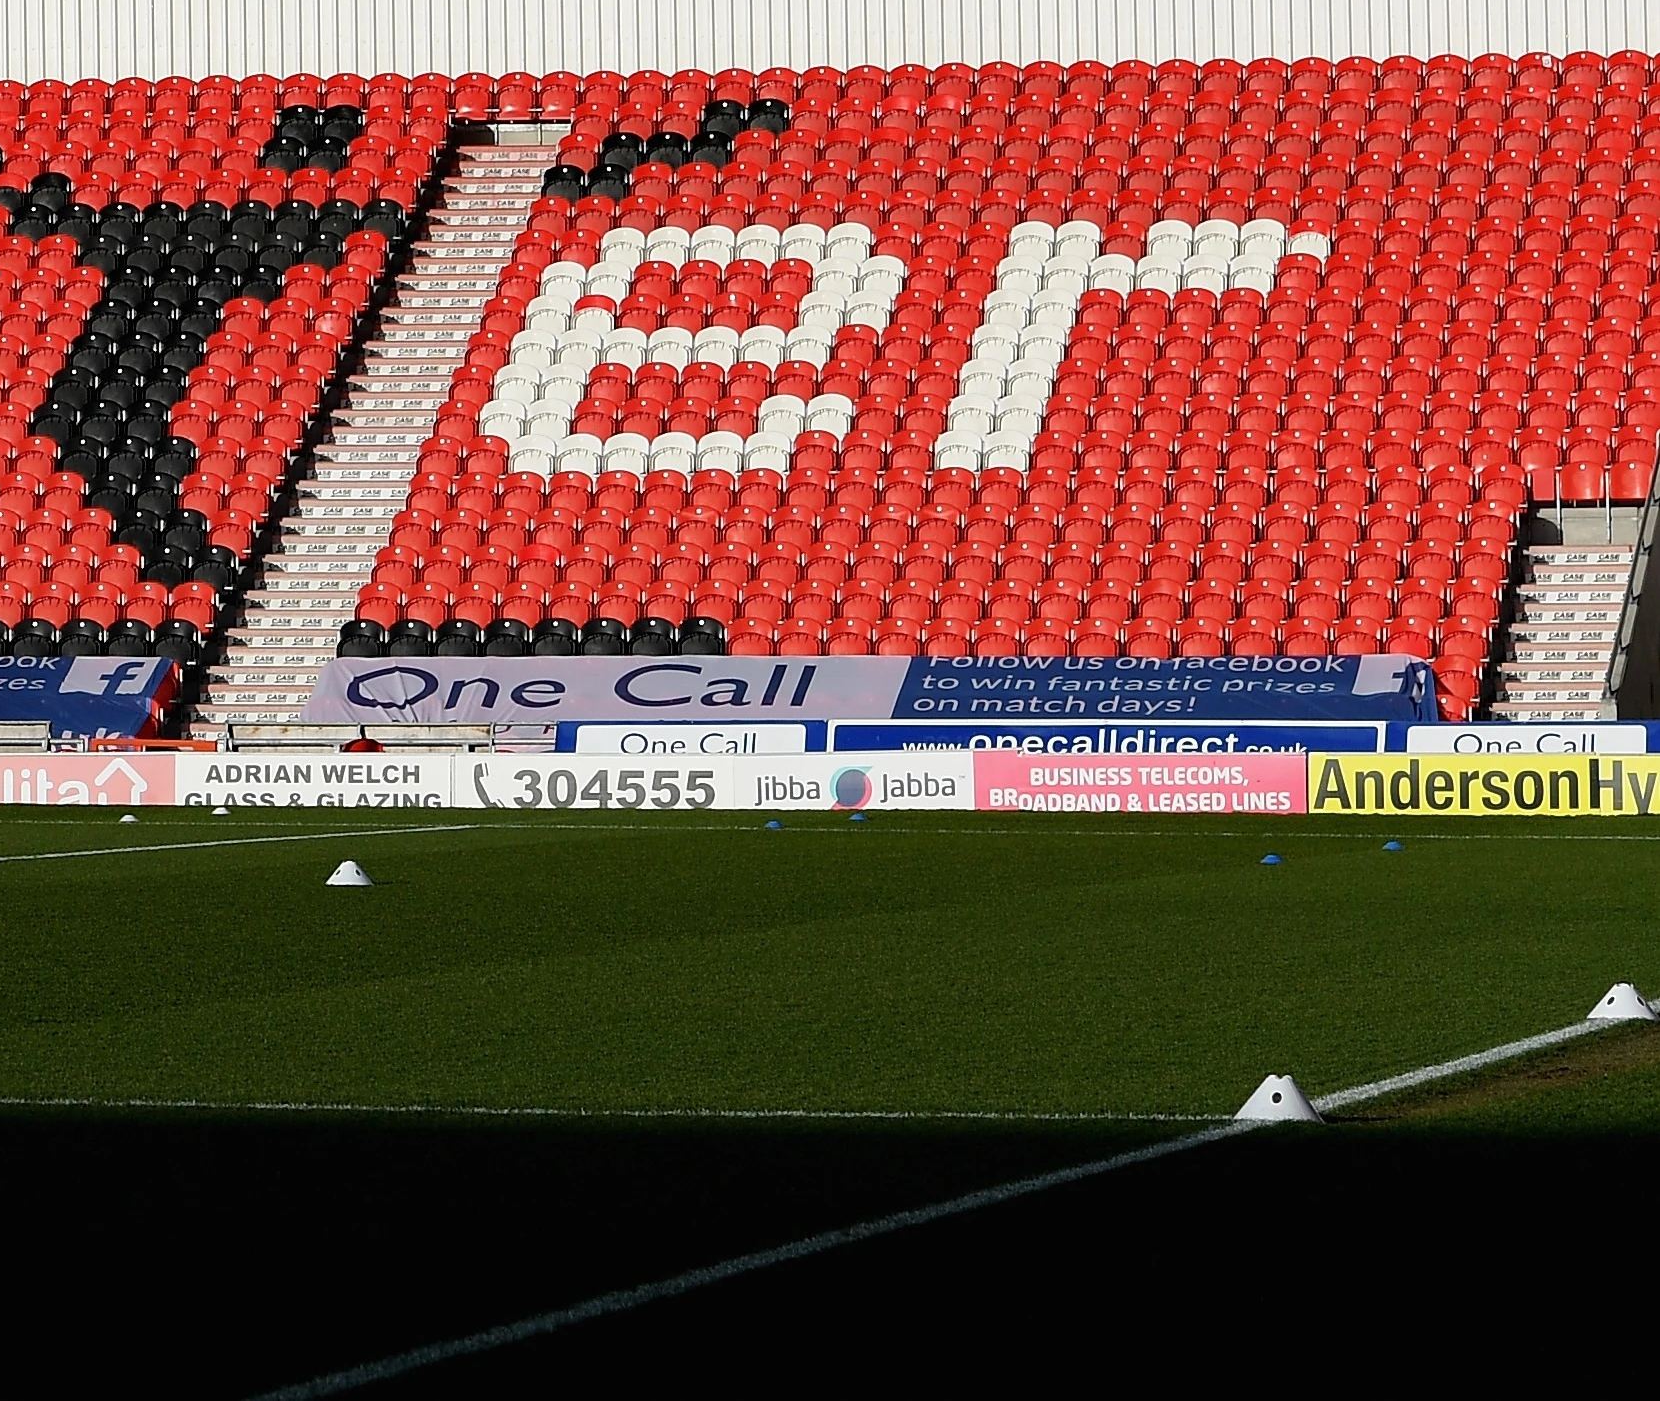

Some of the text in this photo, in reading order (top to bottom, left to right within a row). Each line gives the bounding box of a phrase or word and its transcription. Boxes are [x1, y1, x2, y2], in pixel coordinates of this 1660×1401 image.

[1063, 657, 1104, 670] us
[1115, 657, 1161, 670] on
[1171, 655, 1344, 672] facebook
[346, 664, 817, 709] One Call
[921, 675, 1336, 694] to win fantastic prizes
[912, 695, 1197, 715] on match days!
[620, 732, 757, 754] One Call
[1453, 733, 1595, 754] One Call
[205, 764, 421, 783] ADRIAN WELCH
[1030, 766, 1248, 788] BUSINESS TELECOMS,
[513, 769, 716, 809] 304555
[755, 772, 955, 805] Jibba Jabba
[185, 792, 442, 808] GLASS & GLAZING
[989, 788, 1291, 812] BROADBAND & LEASED LINES
